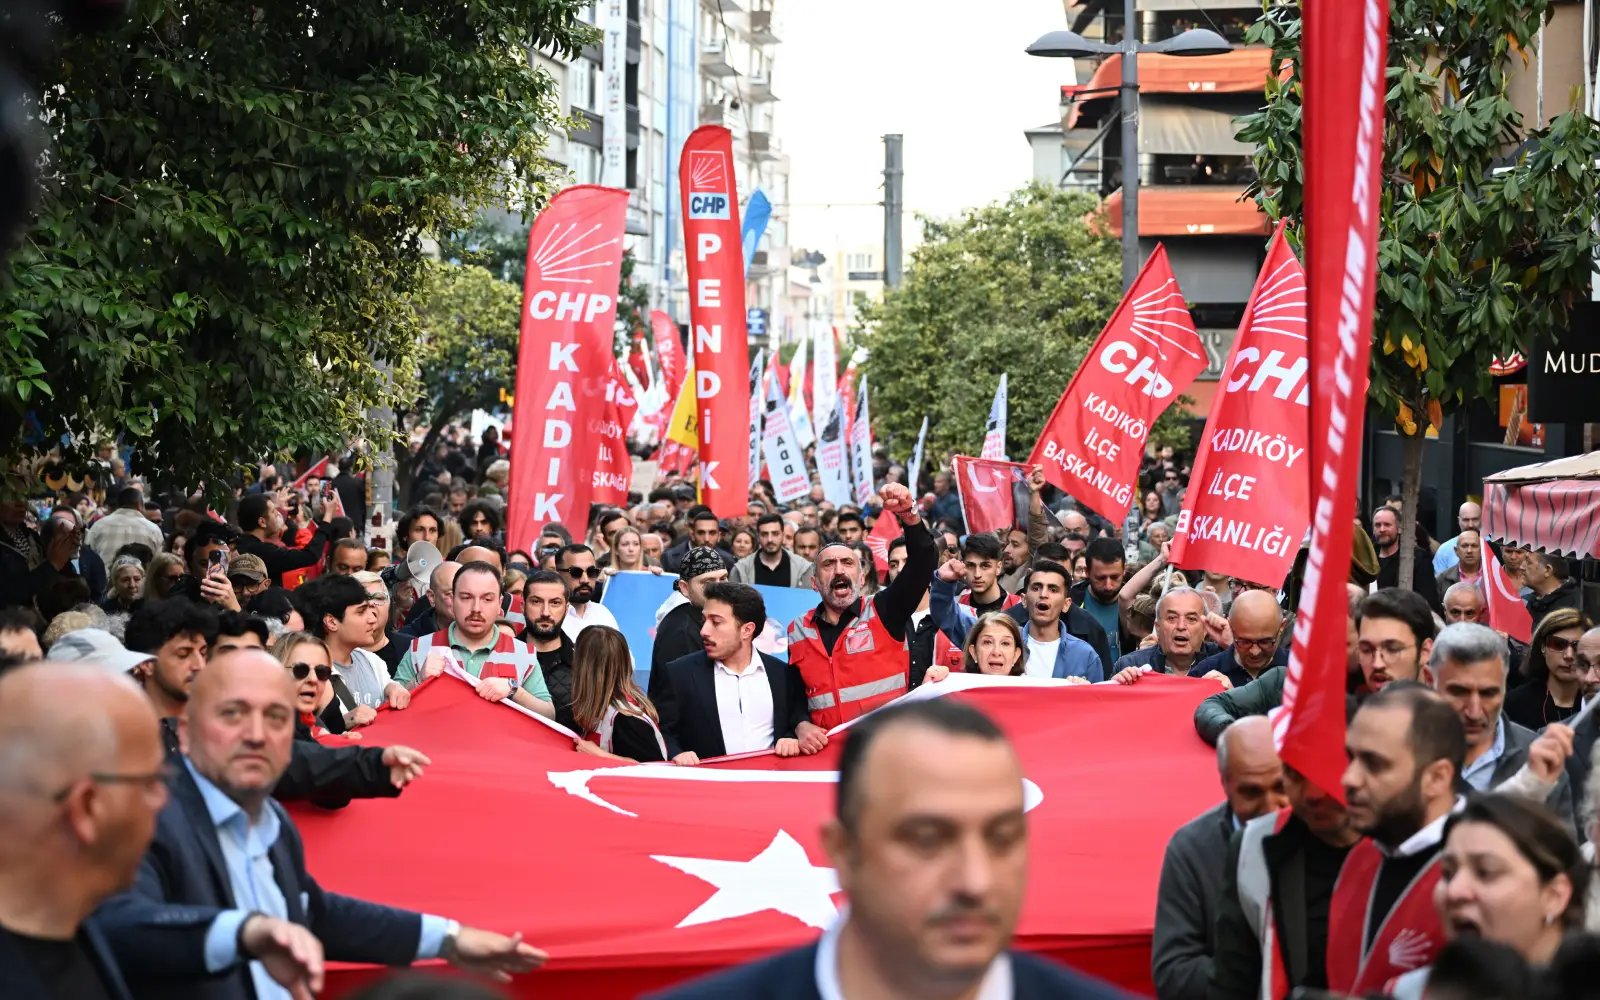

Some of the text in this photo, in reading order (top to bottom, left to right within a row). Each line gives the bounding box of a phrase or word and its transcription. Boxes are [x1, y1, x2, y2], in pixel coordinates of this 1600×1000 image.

[691, 196, 726, 215] CHP
[529, 289, 612, 324] CHP
[697, 233, 723, 490] PENDİK
[1100, 340, 1173, 399] CHP
[1083, 392, 1148, 444] KADIKÖY
[1083, 427, 1121, 463] İLÇE
[1210, 427, 1304, 468] KADIKÖY
[1043, 440, 1132, 508] BAŞKANLIĞI
[1207, 467, 1257, 502] İLÇE
[1175, 509, 1292, 558] BŞKANLIĞI
